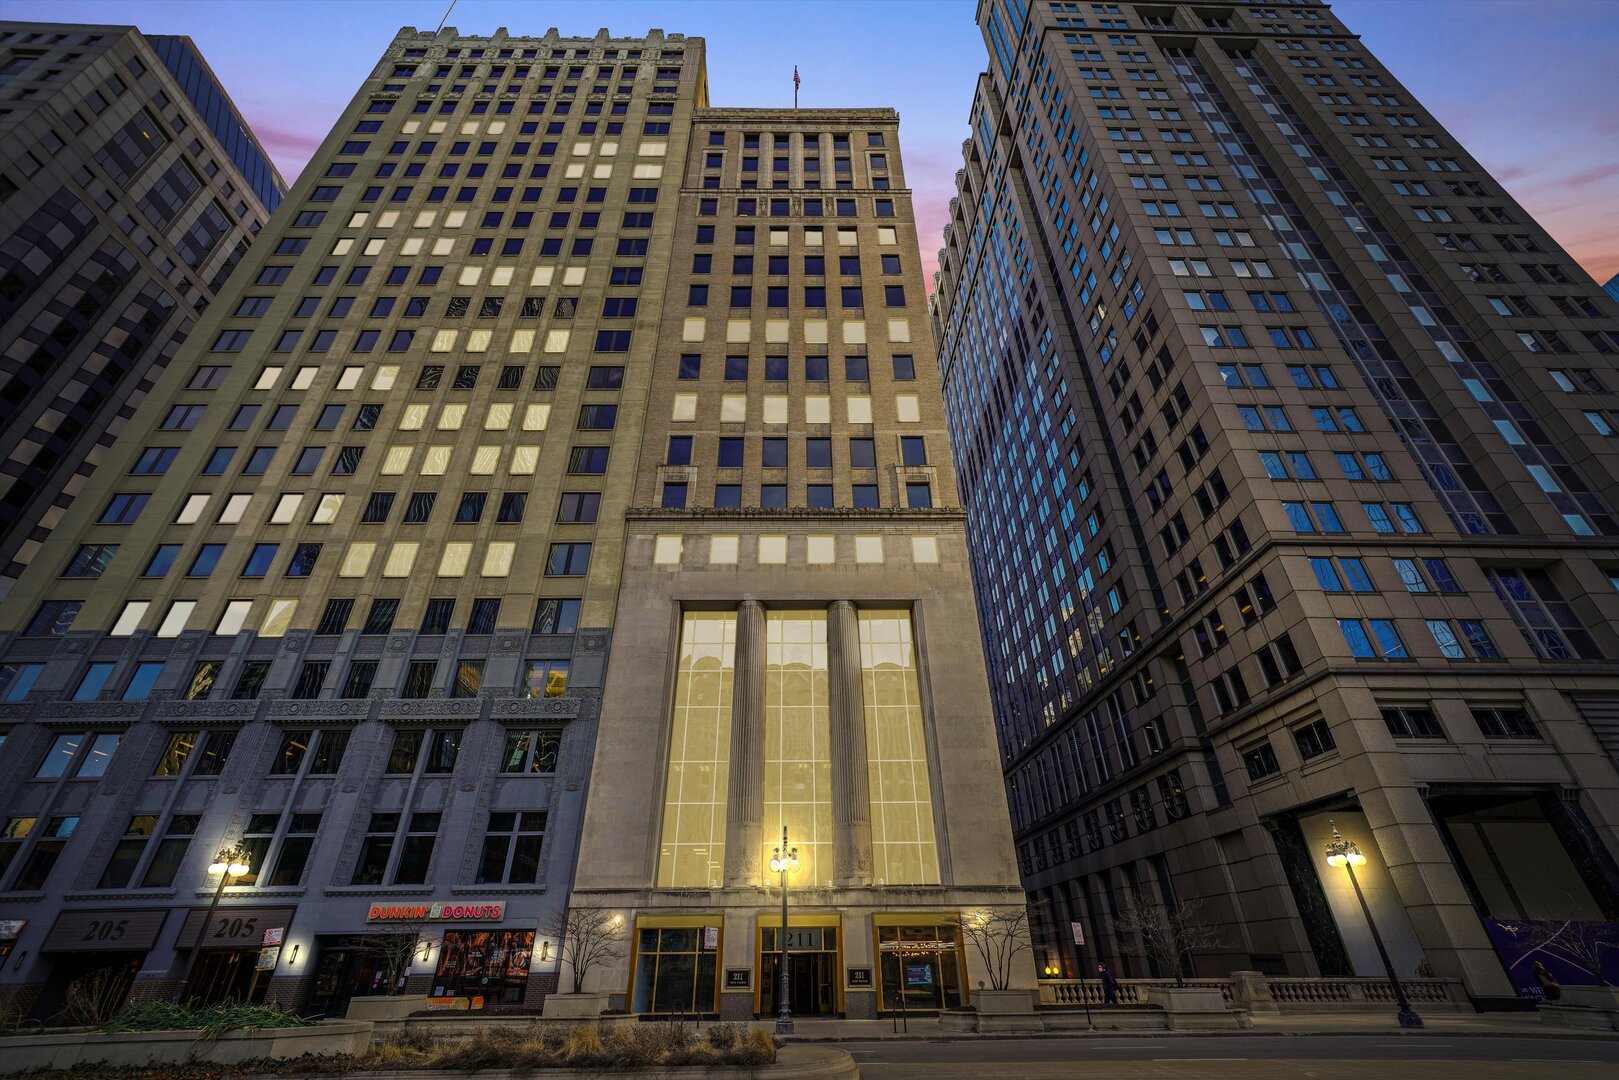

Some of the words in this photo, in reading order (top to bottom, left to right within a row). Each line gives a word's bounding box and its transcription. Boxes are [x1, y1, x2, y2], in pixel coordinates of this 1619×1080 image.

[369, 905, 429, 919] DUNKIN'
[442, 905, 500, 919] DONUTS
[82, 919, 130, 941] 205
[213, 917, 258, 939] 205
[786, 932, 813, 947] 211
[733, 972, 743, 980] 211
[855, 971, 864, 979] 211
